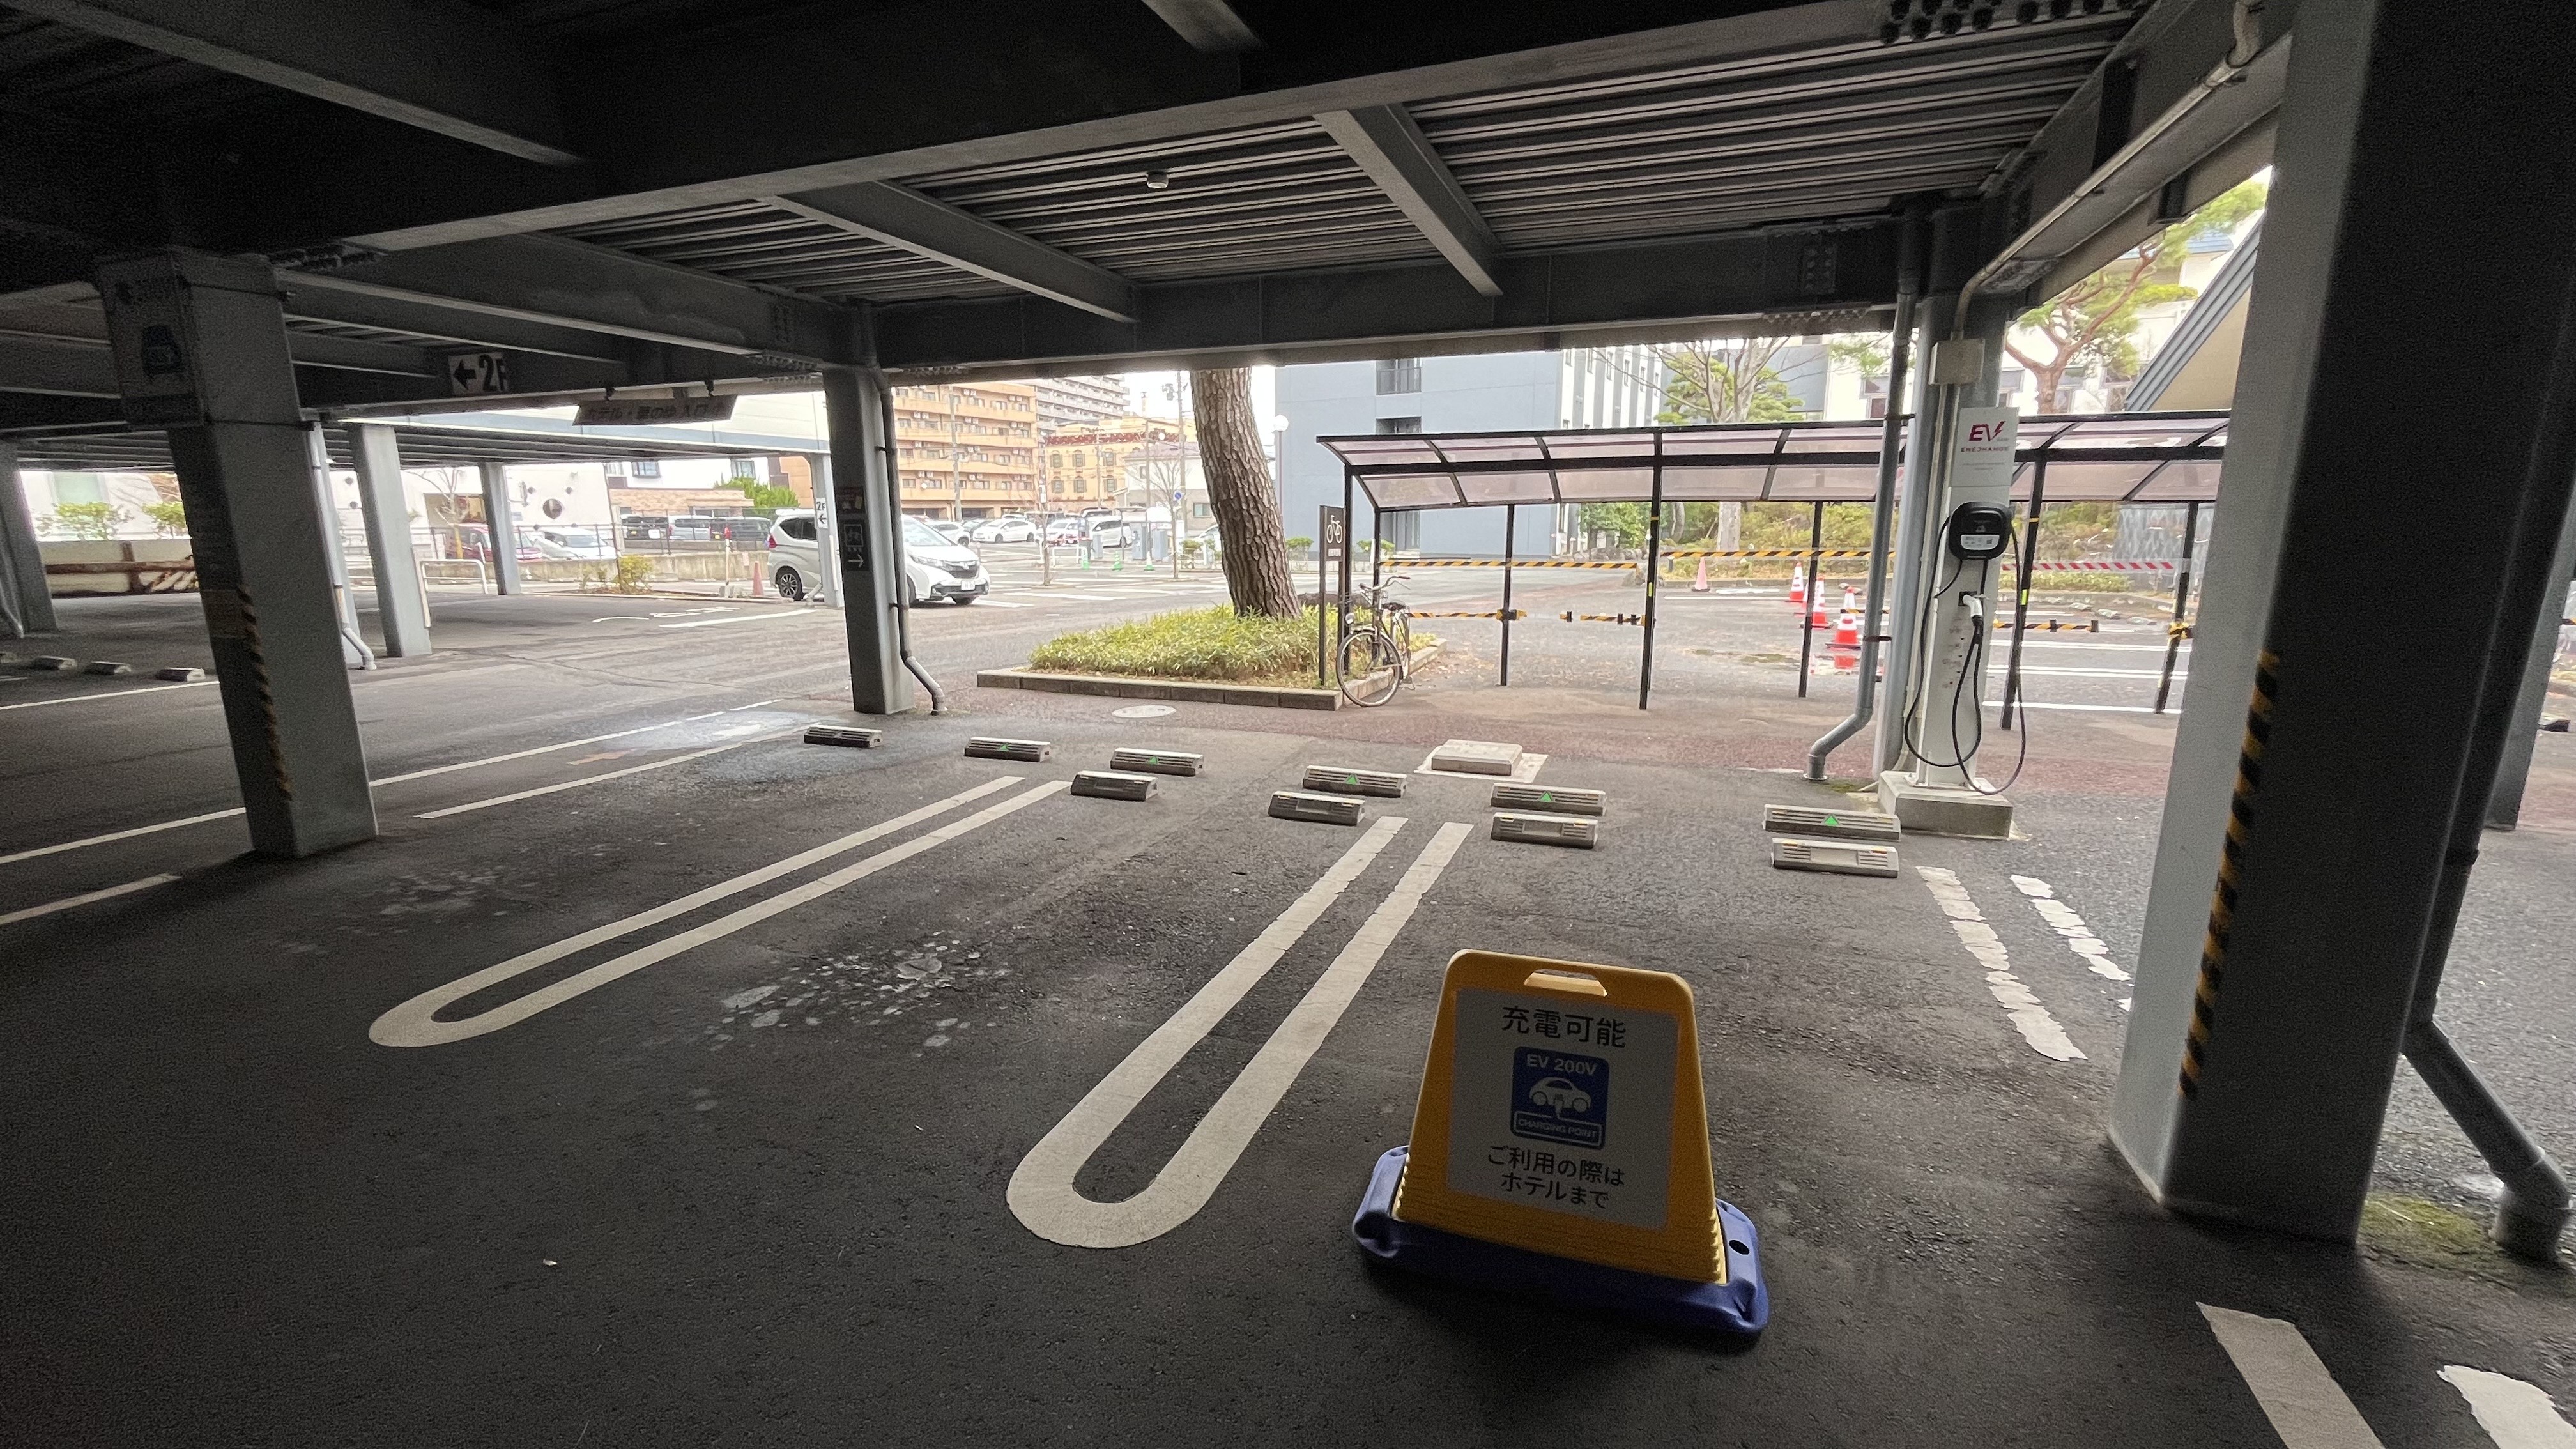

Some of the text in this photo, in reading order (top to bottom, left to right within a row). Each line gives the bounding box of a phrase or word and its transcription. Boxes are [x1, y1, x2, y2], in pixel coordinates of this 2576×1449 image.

[479, 353, 507, 392] 2F
[1968, 420, 2006, 442] EV
[816, 501, 825, 511] 2F
[1501, 1005, 1627, 1048] 充電可能
[1526, 1054, 1598, 1076] EV 200V
[1518, 1118, 1597, 1138] CHARGING POINT
[1488, 1145, 1625, 1186] ご利用の際は
[1501, 1172, 1609, 1209] ホテルまで
